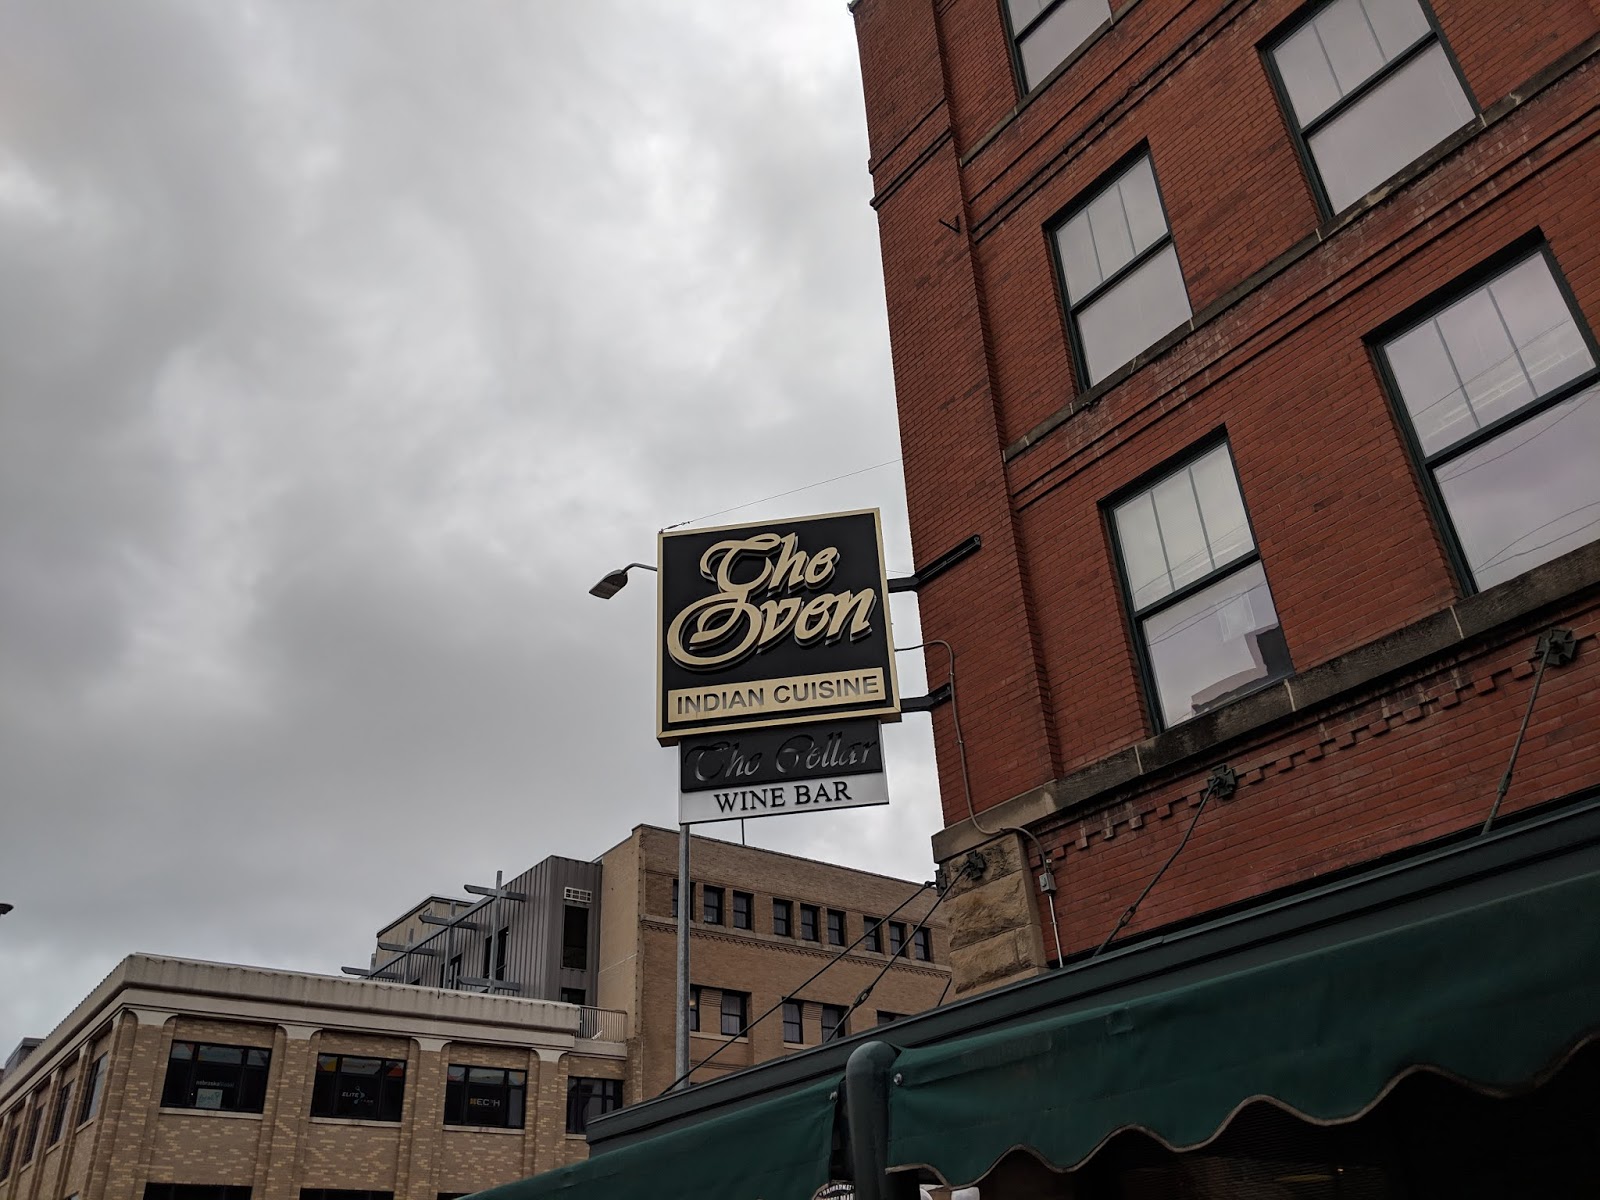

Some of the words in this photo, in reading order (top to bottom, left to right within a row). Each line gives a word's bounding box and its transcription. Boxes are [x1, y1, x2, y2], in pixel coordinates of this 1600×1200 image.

[700, 532, 839, 595] The
[667, 587, 876, 669] Oven
[677, 688, 765, 715] INDIAN
[773, 675, 879, 705] CUISINE
[685, 741, 763, 782] The
[775, 731, 877, 774] Cellar
[714, 787, 786, 813] WINE
[794, 781, 852, 805] BAR
